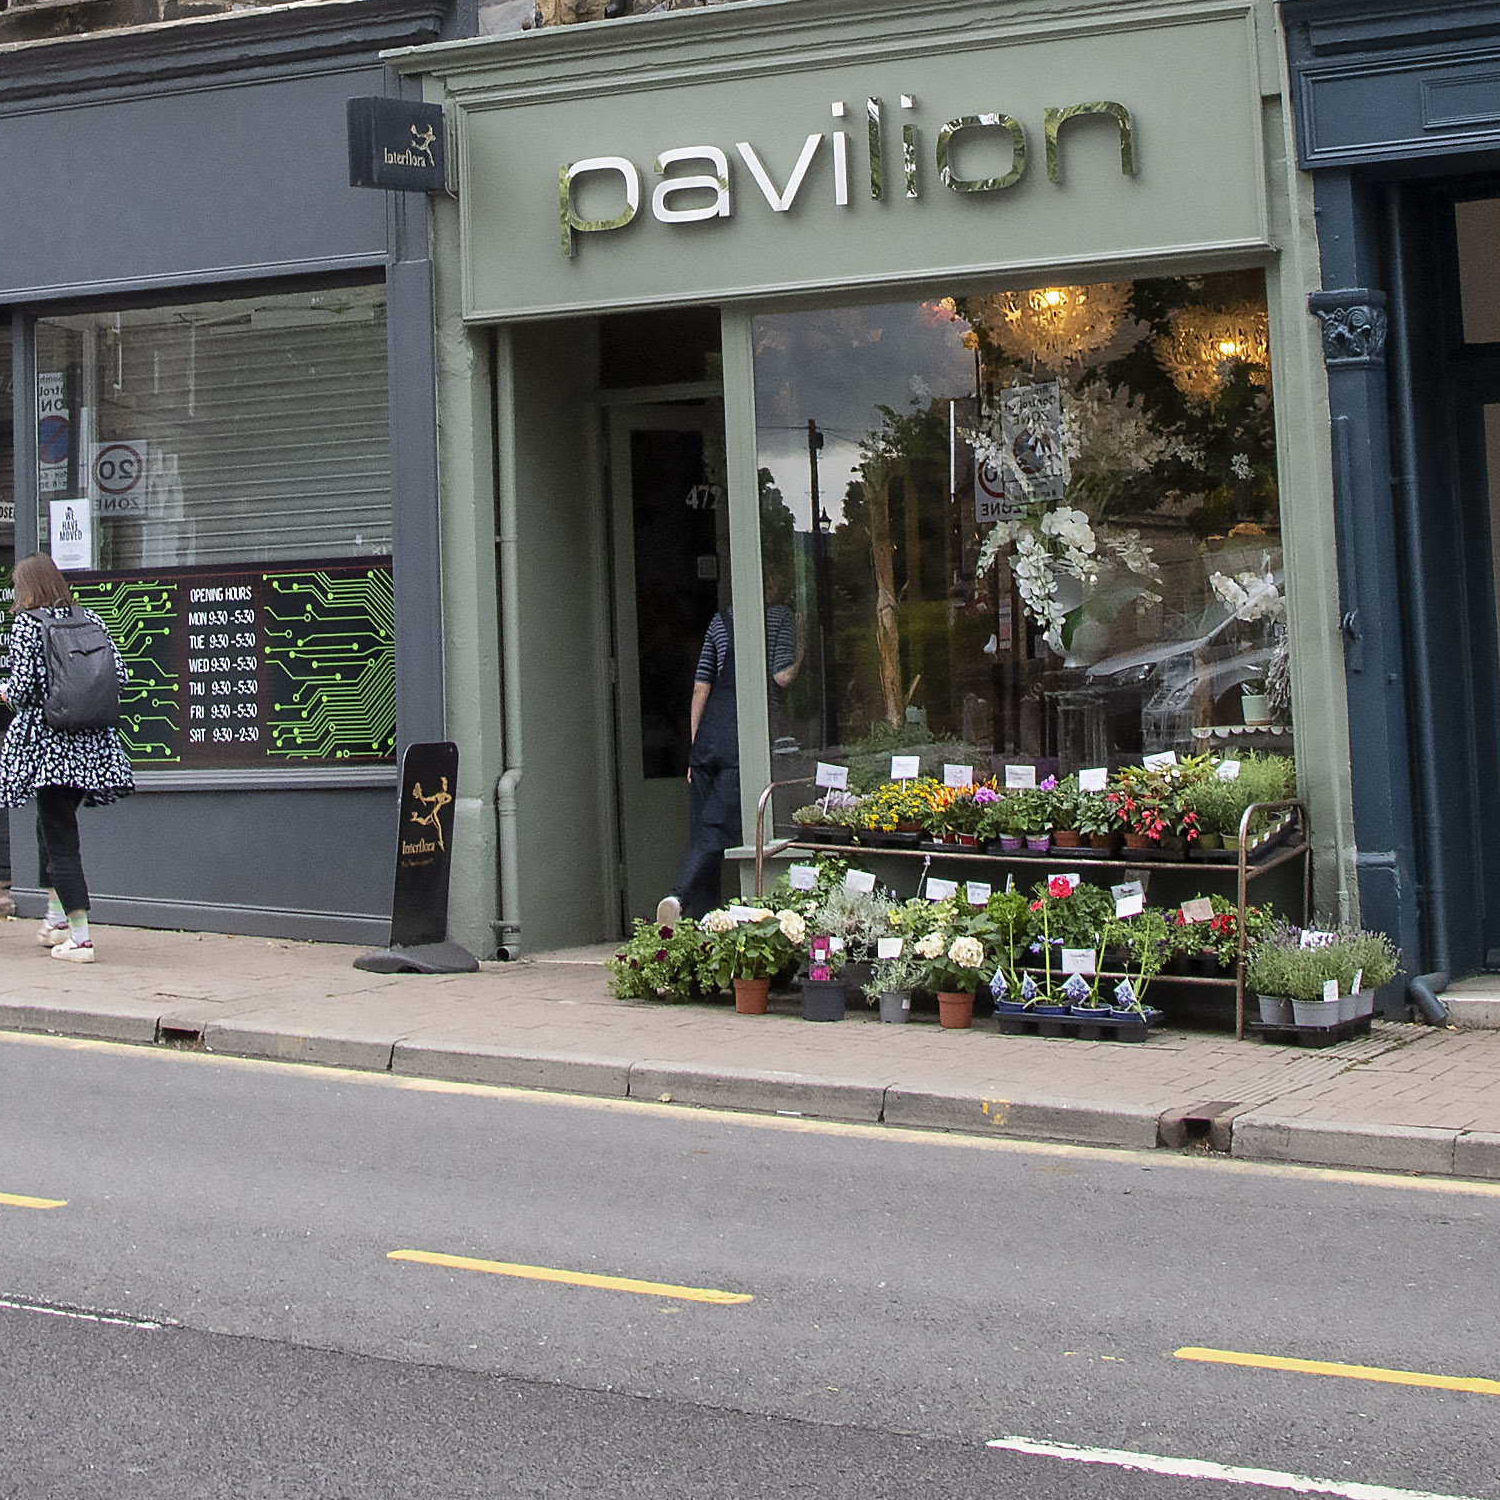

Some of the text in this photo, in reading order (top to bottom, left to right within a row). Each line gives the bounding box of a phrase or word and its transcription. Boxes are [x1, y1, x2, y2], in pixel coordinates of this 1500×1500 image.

[384, 147, 426, 168] Interflora
[558, 94, 1135, 259] pavilion
[62, 520, 78, 531] HAVE
[59, 530, 83, 541] MOVED
[190, 586, 252, 603] OPENING HOURS
[189, 612, 207, 626] MON
[208, 611, 228, 625] 9:30
[189, 635, 205, 649] TUE
[209, 634, 229, 648] 9:30
[189, 658, 209, 673] WED
[211, 657, 231, 672] 9:30
[189, 682, 205, 696] THU
[211, 681, 231, 695] 9:30
[190, 705, 205, 719] FRI
[211, 704, 231, 719] 9:30
[189, 728, 206, 743] SAT
[212, 727, 233, 742] 9:30
[402, 838, 436, 855] Interflora
